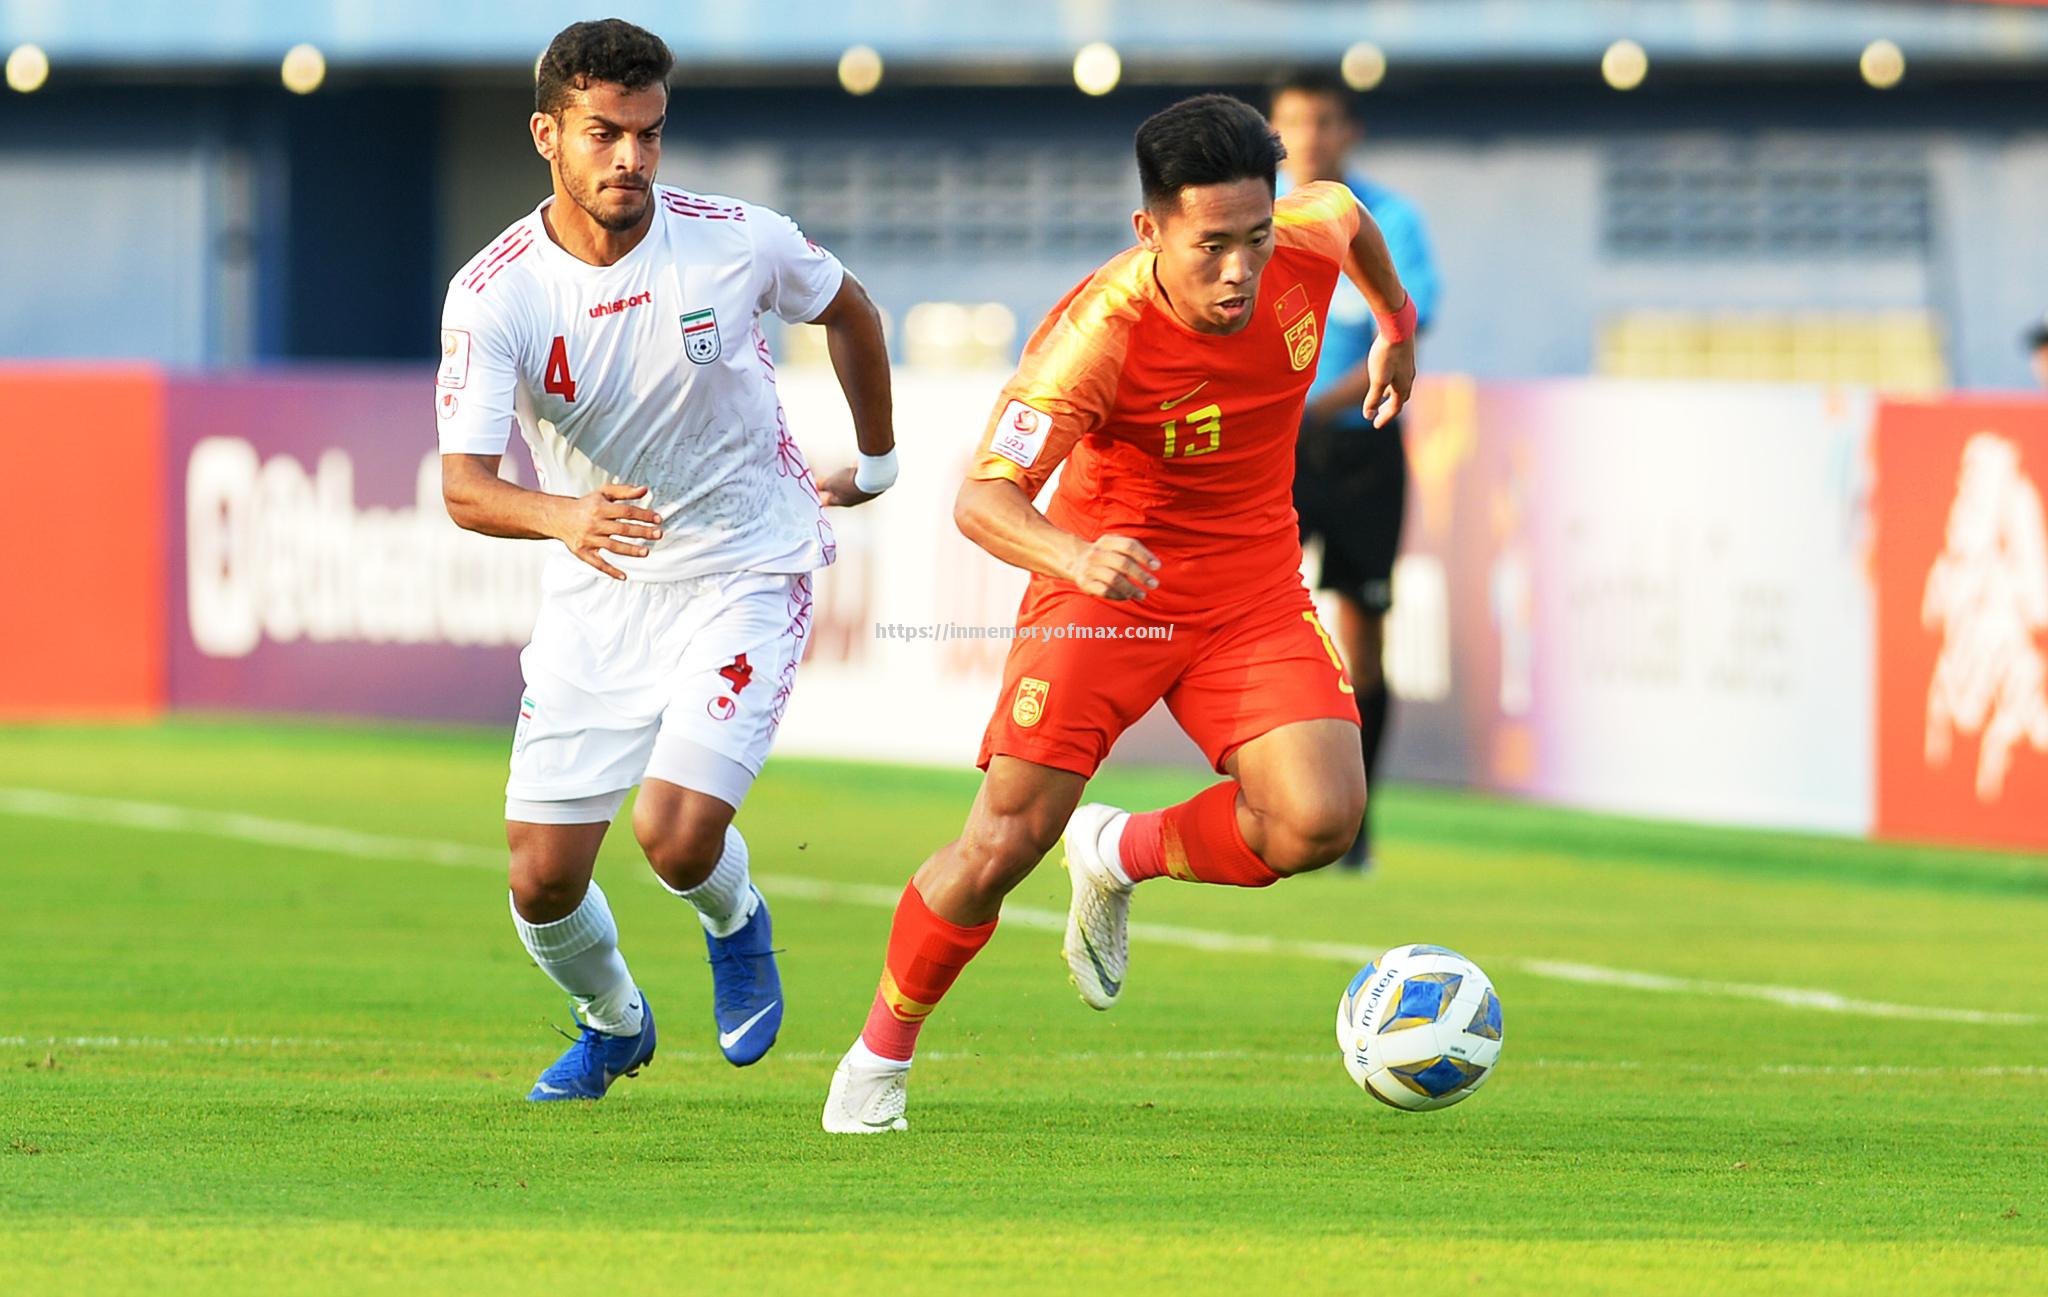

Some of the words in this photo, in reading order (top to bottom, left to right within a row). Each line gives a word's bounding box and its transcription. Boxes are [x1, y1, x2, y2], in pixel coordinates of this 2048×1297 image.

[588, 290, 653, 319] uhlsport
[543, 335, 577, 403] 4
[1160, 403, 1222, 459] 13
[718, 652, 754, 696] 4
[1361, 968, 1399, 1028] molten
